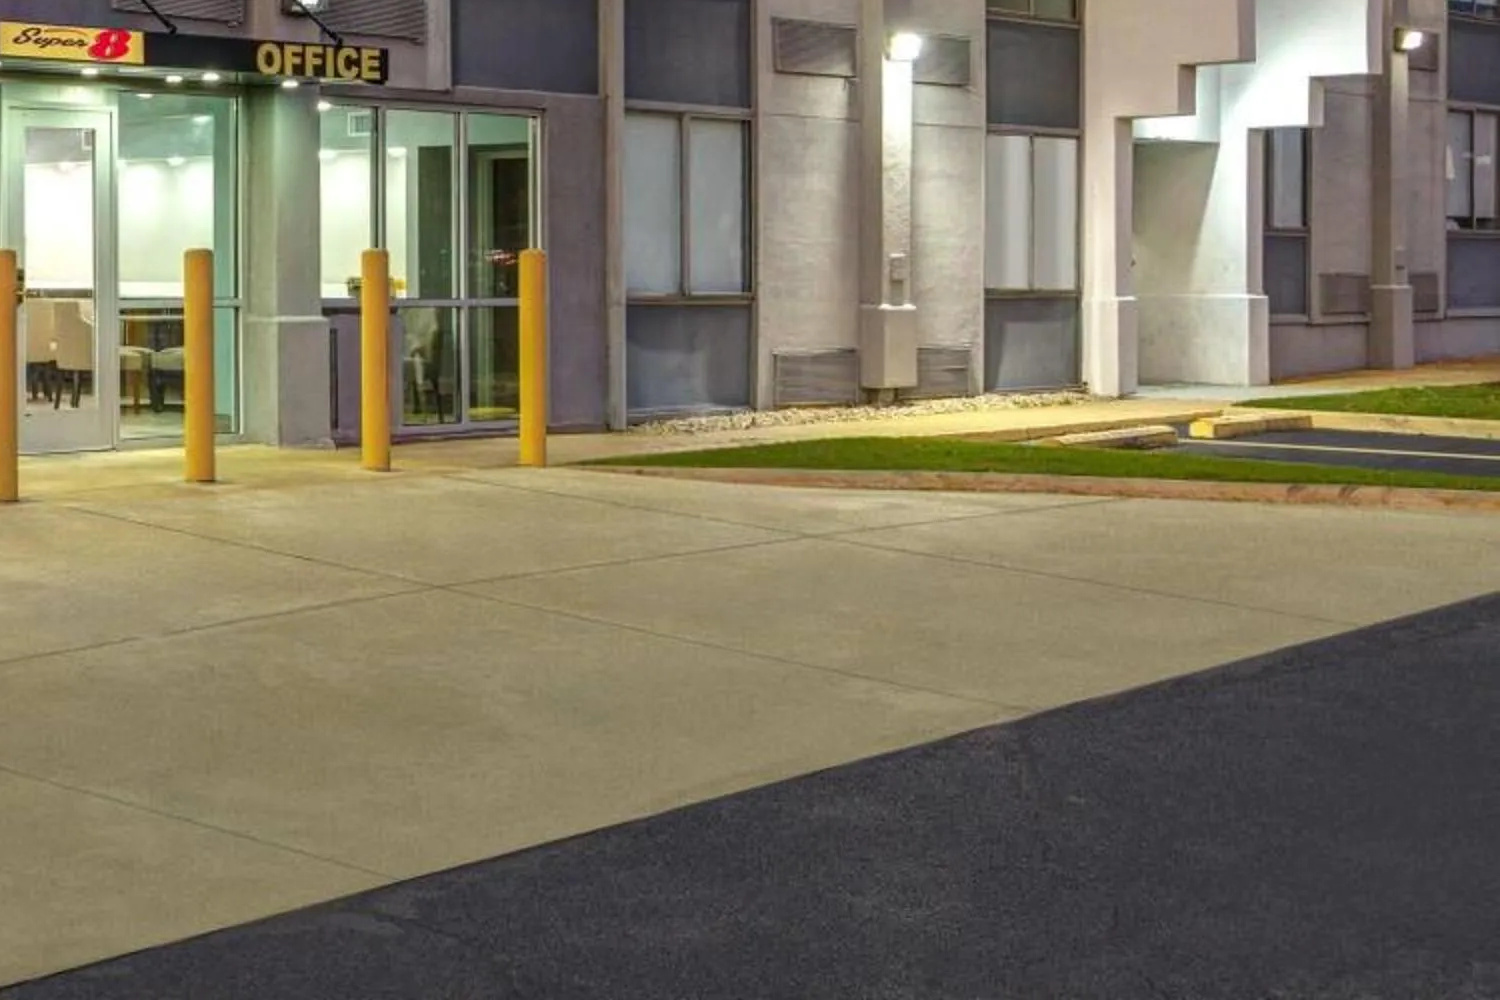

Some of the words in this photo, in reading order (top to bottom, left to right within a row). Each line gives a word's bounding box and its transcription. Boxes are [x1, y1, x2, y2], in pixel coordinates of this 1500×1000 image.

[13, 27, 88, 49] Super
[87, 27, 133, 60] 8
[256, 42, 381, 80] OFFICE
